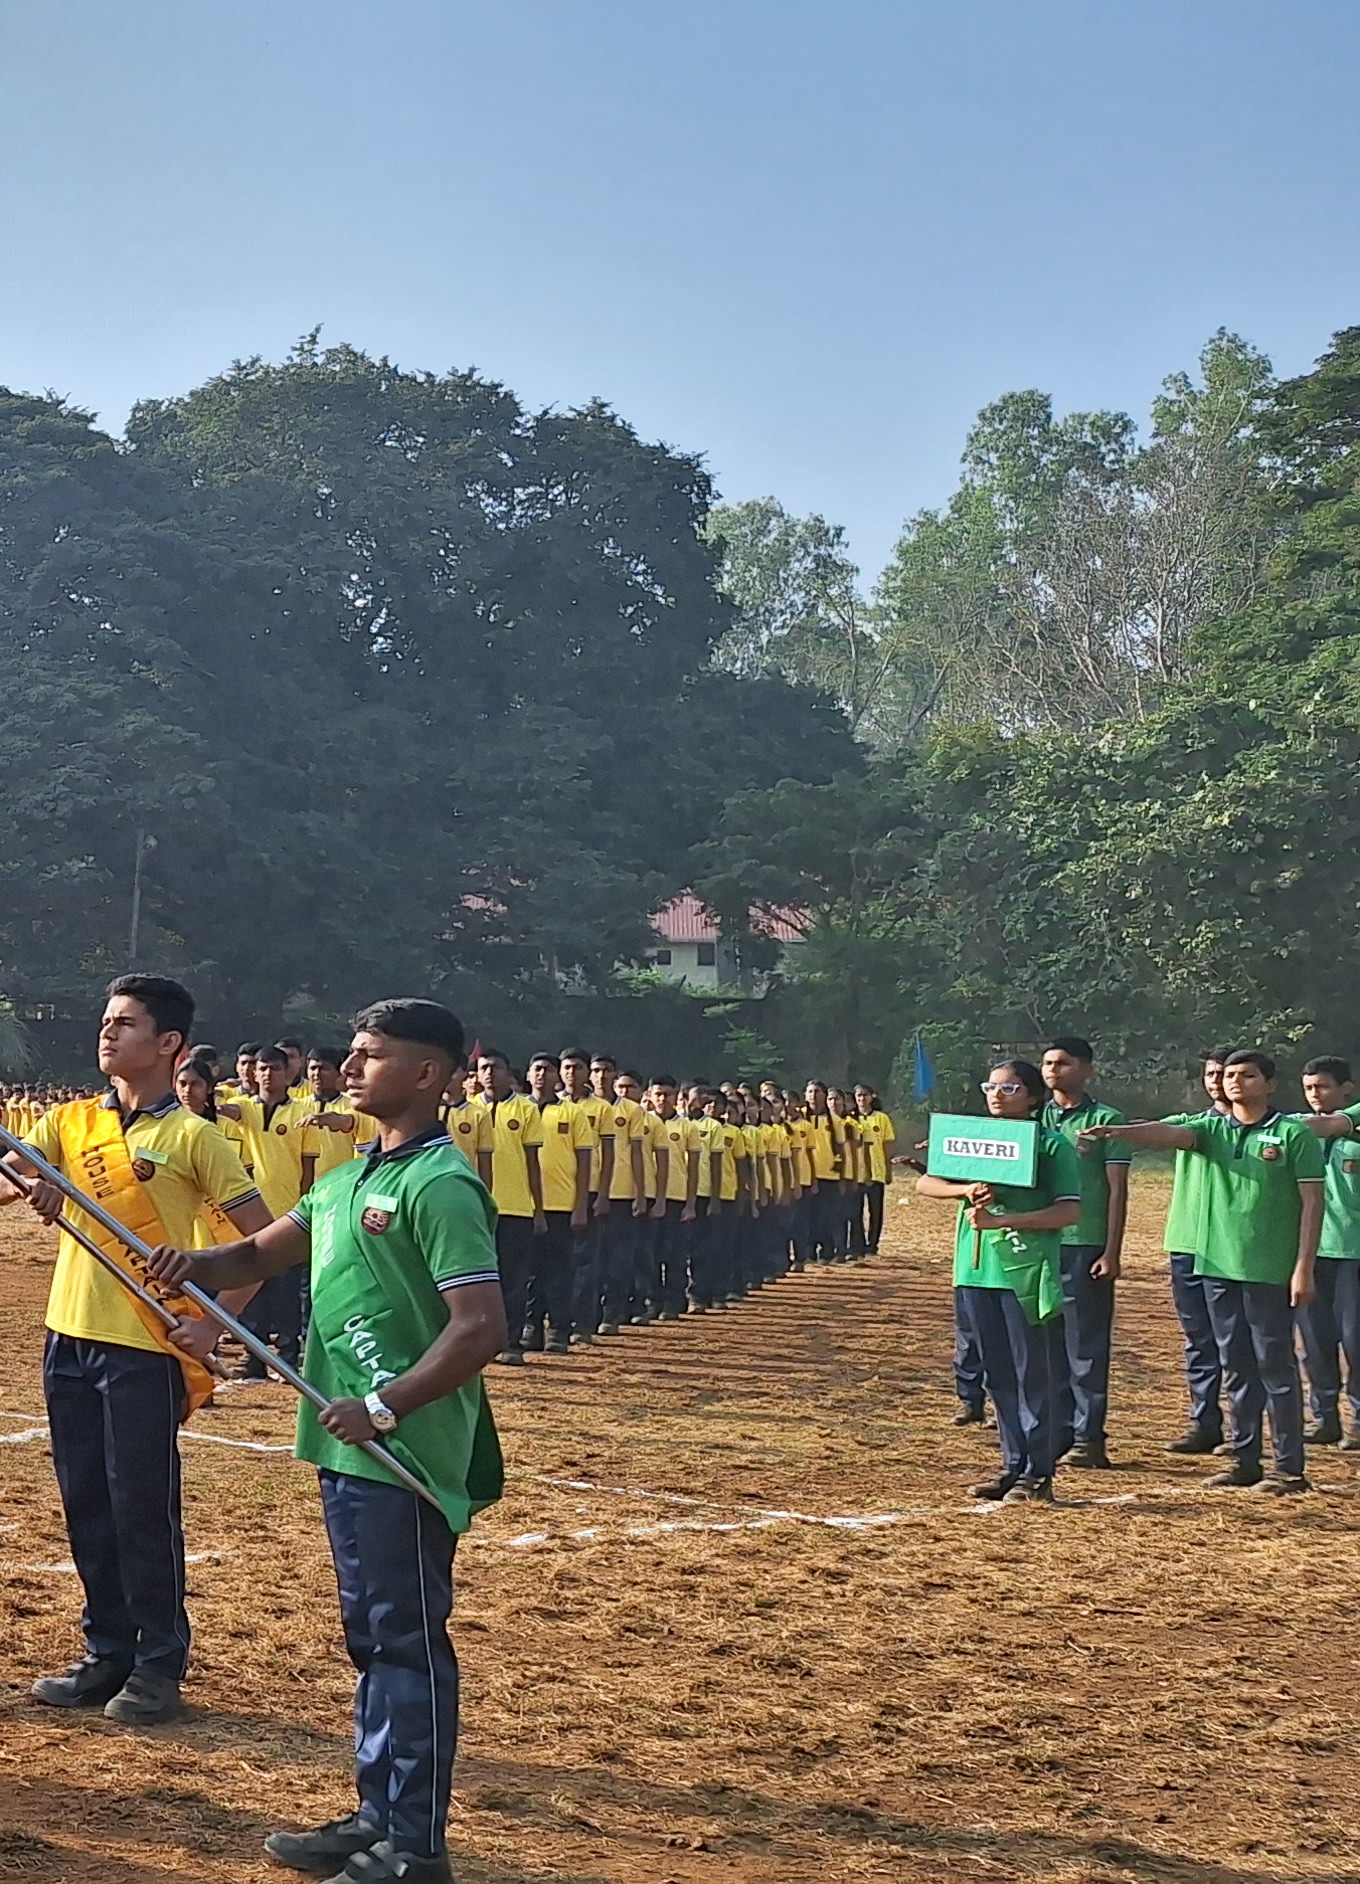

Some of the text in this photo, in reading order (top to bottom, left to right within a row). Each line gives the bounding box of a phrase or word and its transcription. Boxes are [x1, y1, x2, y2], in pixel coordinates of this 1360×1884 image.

[81, 1146, 115, 1200] HOUSE
[946, 1139, 1016, 1158] KAVERI
[343, 1314, 397, 1388] CAPTA
